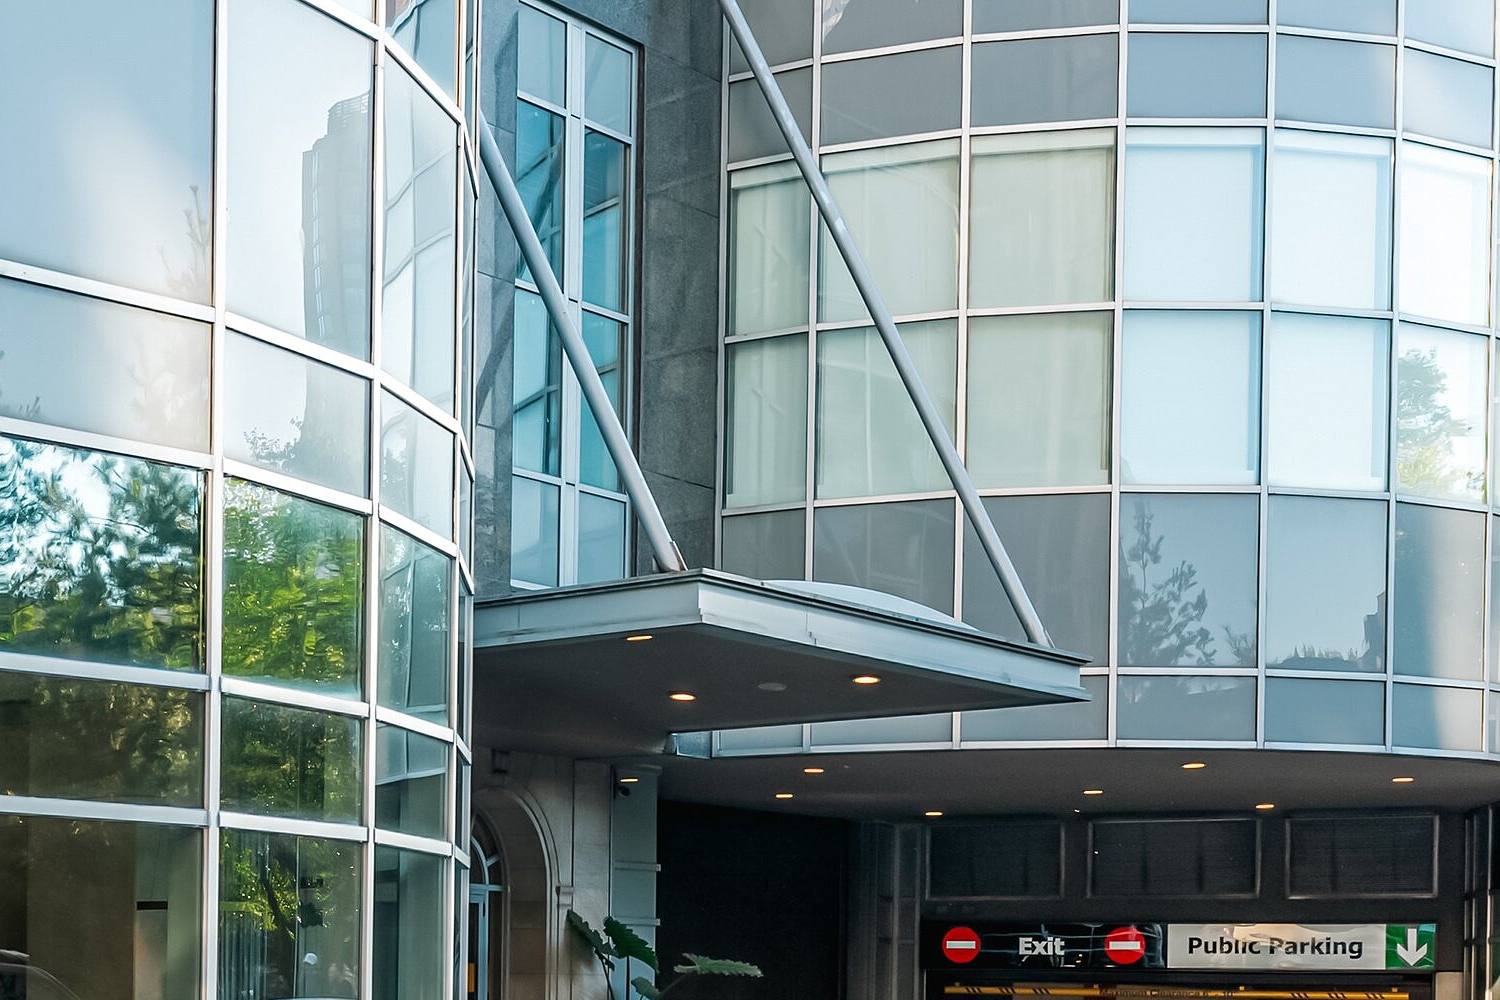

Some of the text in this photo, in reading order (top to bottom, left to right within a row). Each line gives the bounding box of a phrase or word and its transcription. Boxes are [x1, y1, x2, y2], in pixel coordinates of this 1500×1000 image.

[1019, 937, 1065, 956] Exit
[1188, 937, 1363, 960] Public Parking
